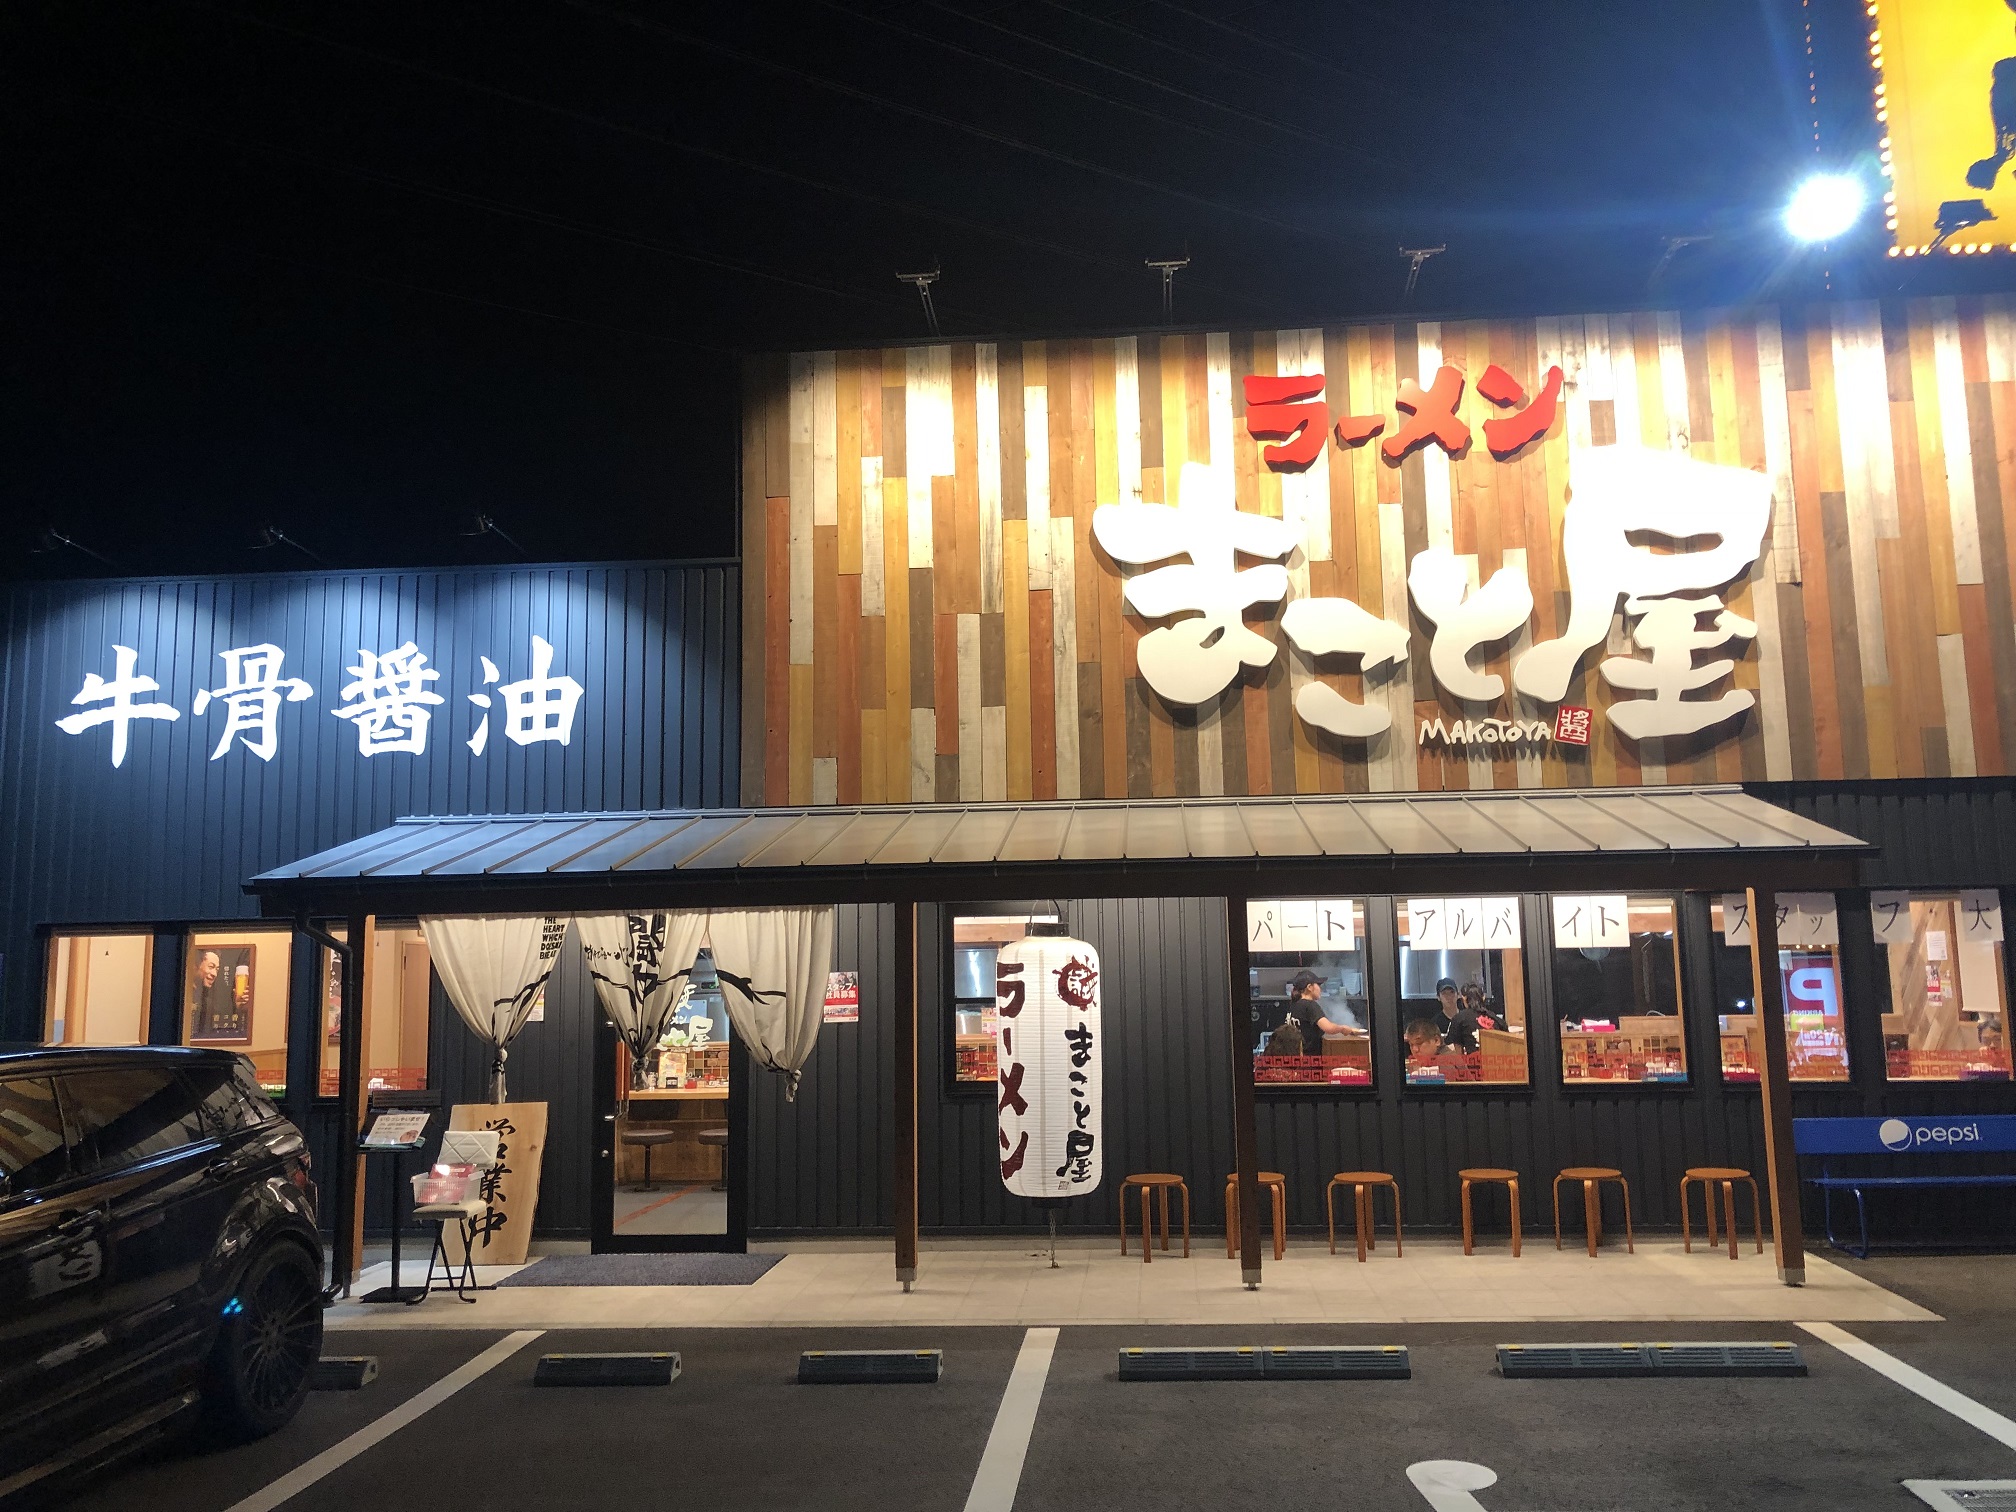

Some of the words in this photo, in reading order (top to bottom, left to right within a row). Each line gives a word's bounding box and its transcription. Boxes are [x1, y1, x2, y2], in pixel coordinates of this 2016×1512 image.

[1243, 365, 1564, 472] ラーメン
[1092, 444, 1773, 740] まこと屋
[54, 635, 585, 769] 牛骨醤油
[1419, 717, 1551, 746] MAKOTOYA
[543, 925, 565, 933] HEART
[1252, 908, 1346, 943] パート
[996, 962, 1029, 1181] ラーメン
[1056, 1021, 1096, 1184] まこと屋
[1915, 1123, 1979, 1146] pepsi
